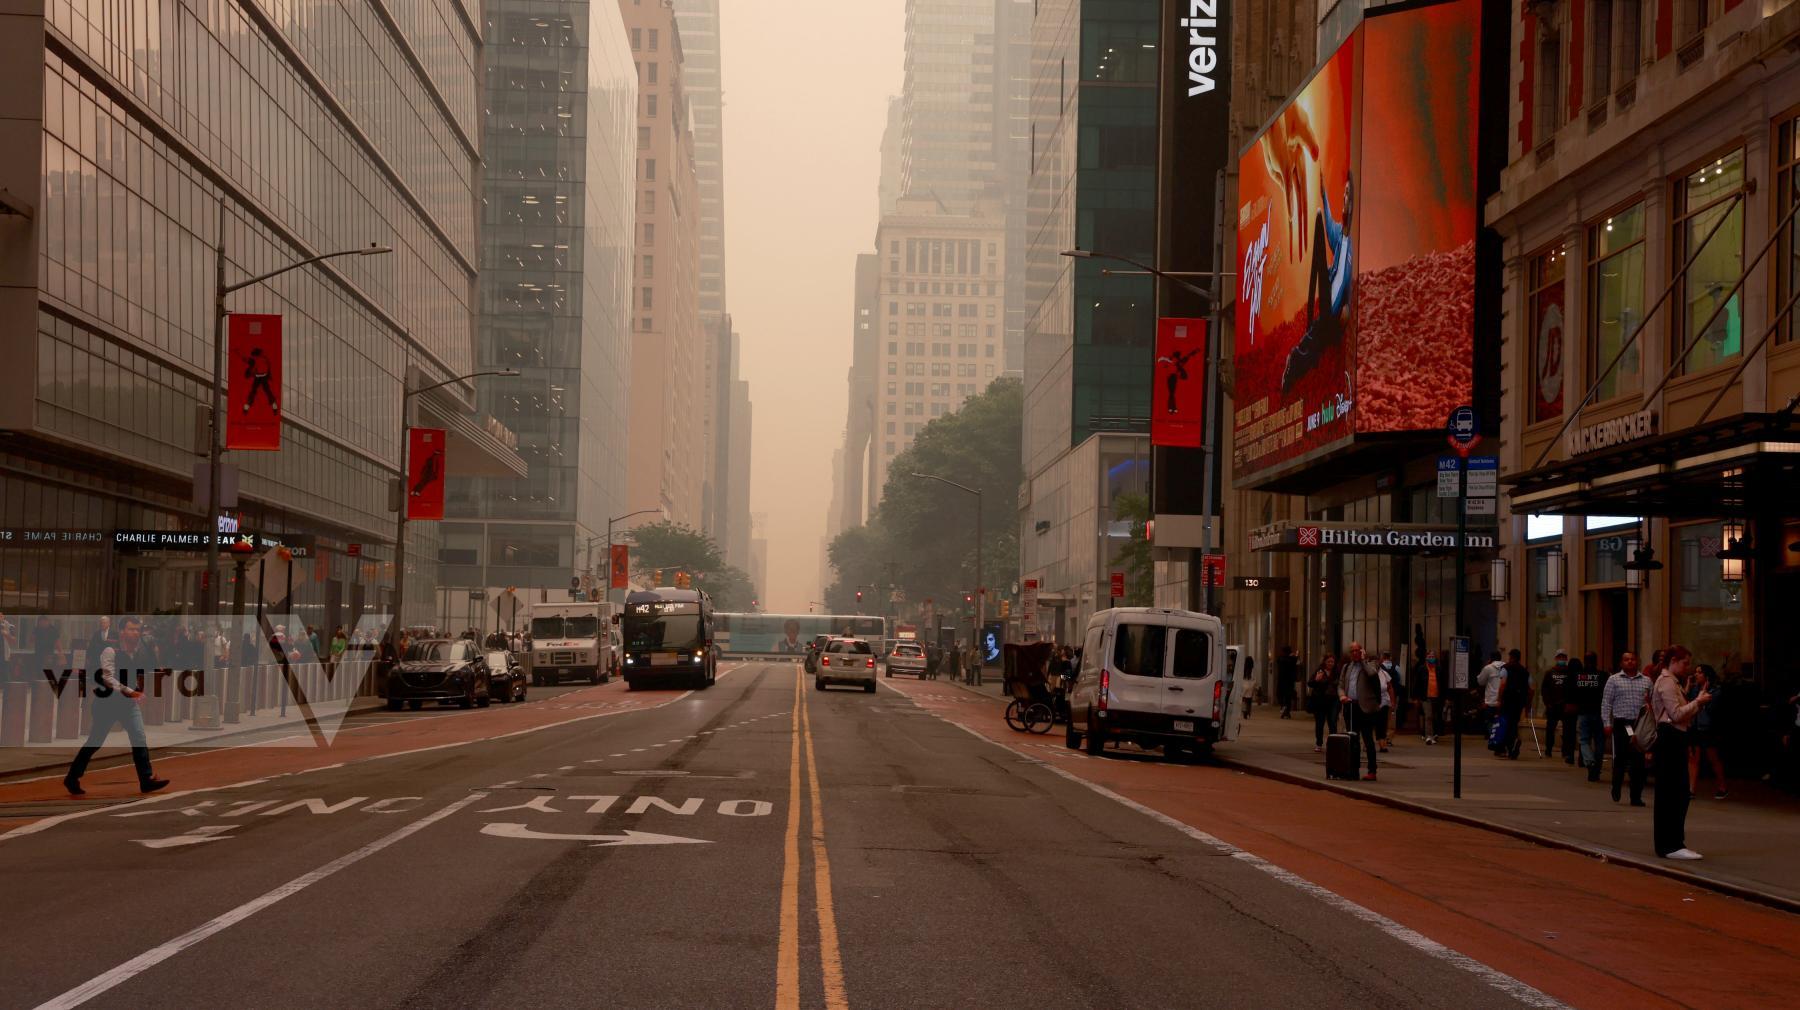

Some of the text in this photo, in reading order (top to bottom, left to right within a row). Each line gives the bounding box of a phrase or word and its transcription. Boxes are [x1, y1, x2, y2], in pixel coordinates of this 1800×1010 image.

[1321, 399, 1335, 425] hulu
[1439, 459, 1456, 469] M42
[116, 533, 236, 545] CHARLIE PALMER SEAK
[1320, 529, 1383, 546] Hilton
[1386, 531, 1455, 547] Garden
[1245, 579, 1259, 587] 130
[636, 604, 649, 613] M42
[476, 796, 773, 817] ONLY
